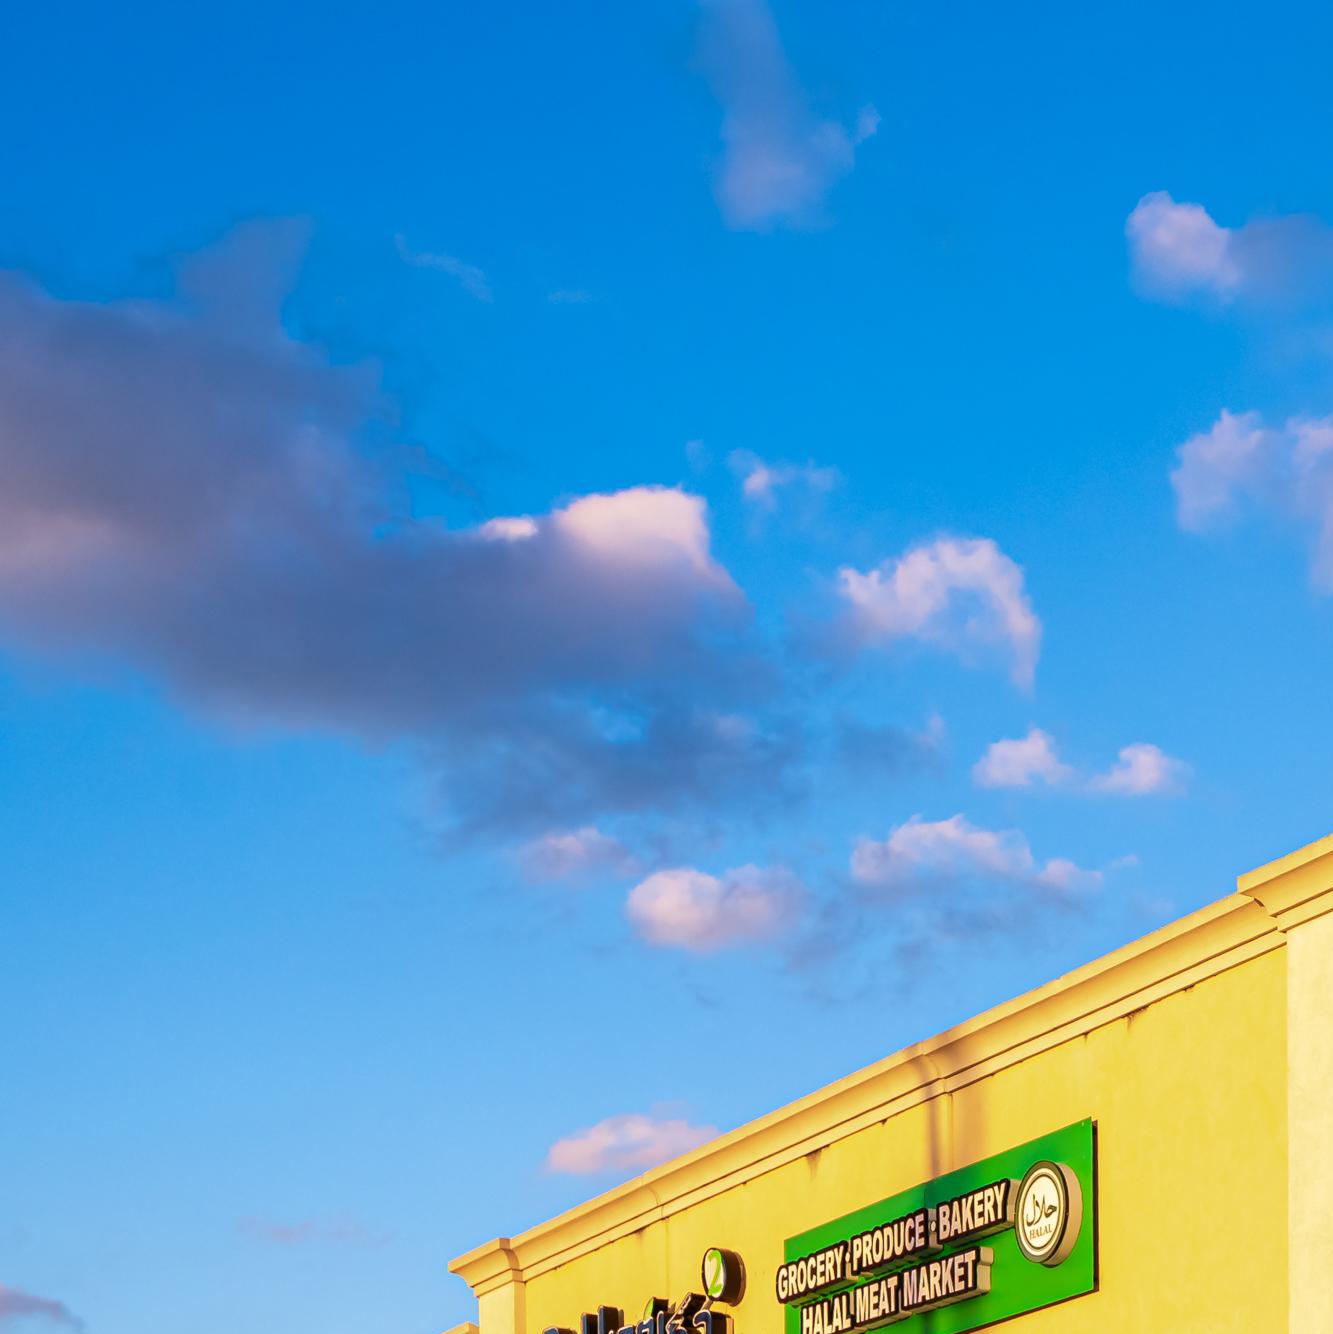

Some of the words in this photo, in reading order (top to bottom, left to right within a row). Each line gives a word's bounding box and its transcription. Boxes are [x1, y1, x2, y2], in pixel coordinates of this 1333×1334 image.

[777, 1245, 845, 1300] GROCERY
[852, 1213, 926, 1272] PRODUCE
[938, 1182, 1007, 1241] BAKERY
[855, 1275, 899, 1324] MEAT
[903, 1250, 977, 1307] MARKET
